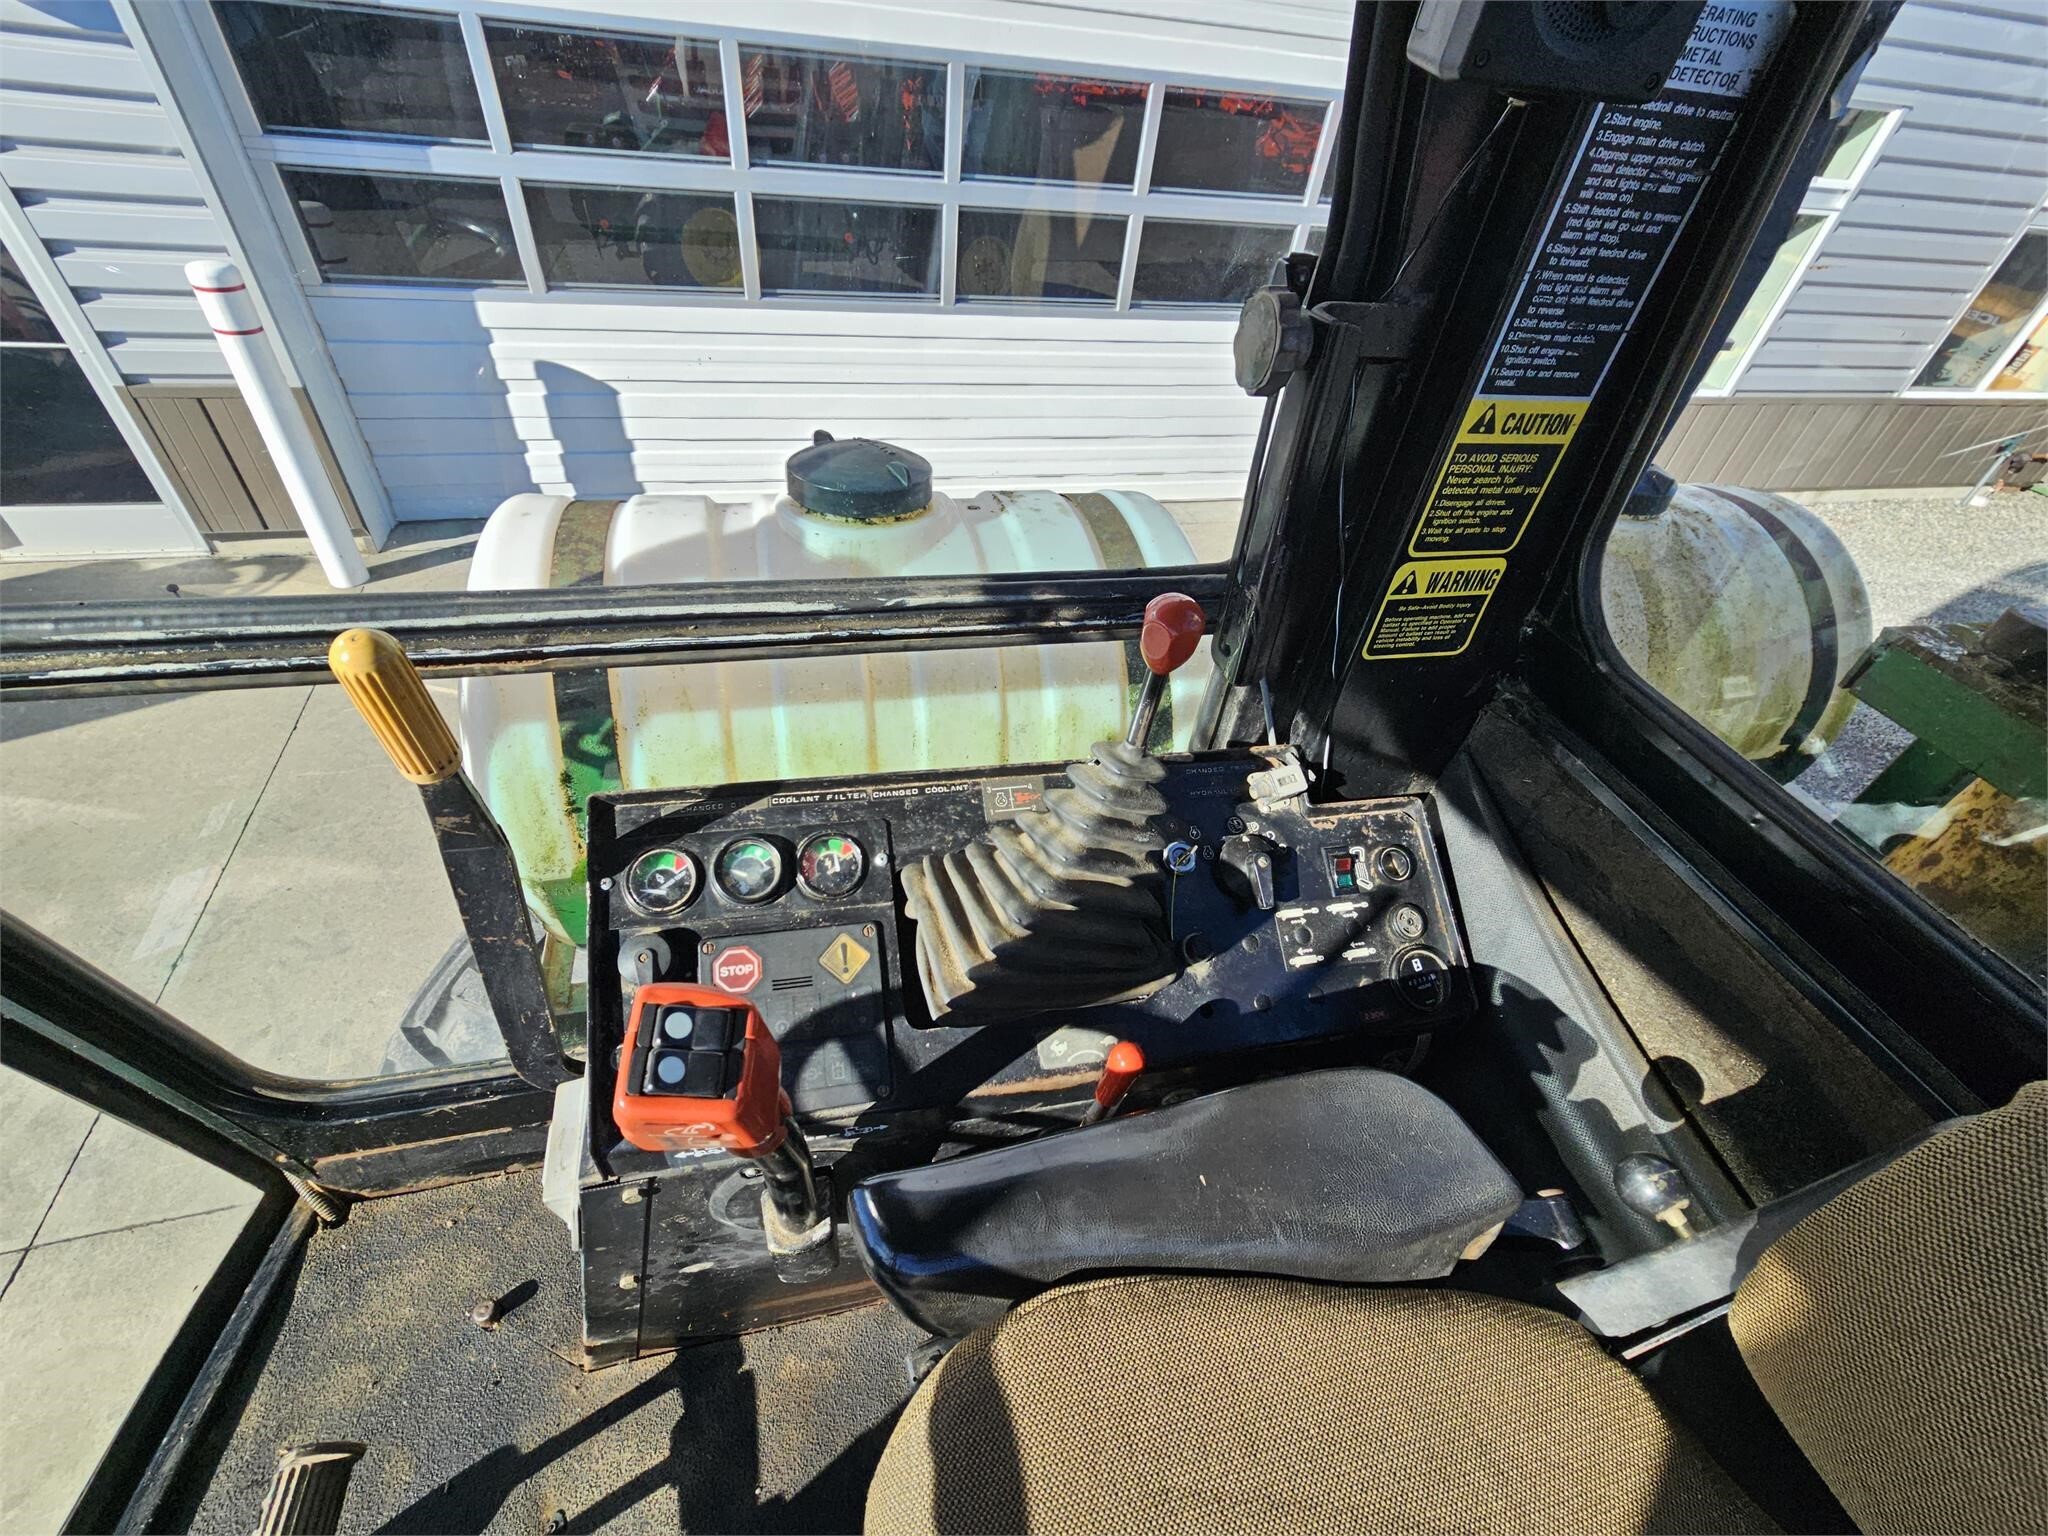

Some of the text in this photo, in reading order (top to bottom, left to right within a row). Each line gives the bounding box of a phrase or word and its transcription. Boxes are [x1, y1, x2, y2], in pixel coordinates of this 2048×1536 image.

[1680, 45, 1722, 65] METAL
[1669, 65, 1740, 90] DETECTOR
[1673, 103, 1694, 116] drive
[1695, 106, 1705, 117] to
[1602, 111, 1662, 130] 2.Start engine.
[1596, 129, 1635, 145] 3.Engage
[1635, 135, 1656, 146] main
[1657, 137, 1679, 149] drive
[1588, 147, 1697, 168] 4.Depress upper portion of
[1591, 162, 1615, 173] metal
[1615, 164, 1650, 177] detector
[1584, 176, 1602, 185] and
[1602, 177, 1618, 187] red
[1617, 178, 1641, 190] lights
[1658, 183, 1682, 194] alarm
[1579, 188, 1595, 198] will
[1594, 191, 1617, 200] come
[1590, 205, 1621, 217] feedroll
[1621, 208, 1641, 219] drive
[1642, 210, 1652, 220] to
[1565, 216, 1584, 228] (red
[1584, 218, 1603, 230] light
[1602, 219, 1619, 230] will
[1618, 222, 1630, 232] go
[1645, 223, 1664, 233] and
[1560, 230, 1583, 239] alarm
[1584, 231, 1600, 240] will
[1579, 246, 1598, 256] shift
[1598, 247, 1628, 258] feedroll
[1627, 249, 1647, 259] drive
[1549, 256, 1559, 266] to
[1534, 270, 1563, 281] 7.When
[1564, 272, 1587, 282] metal
[1587, 273, 1596, 282] is
[1554, 283, 1573, 294] light
[1588, 285, 1611, 295] alarm
[1587, 297, 1616, 307] feedroll
[1615, 299, 1635, 308] drive
[1527, 304, 1565, 316] to reverse
[1538, 318, 1568, 330] feedroll
[1551, 333, 1572, 343] main
[1527, 345, 1541, 356] off
[1540, 347, 1566, 358] engine
[1504, 354, 1531, 367] ignition
[1524, 367, 1538, 378] for
[1537, 369, 1553, 378] and
[1552, 370, 1580, 381] remove
[1501, 412, 1576, 435] CAUTION
[1454, 453, 1539, 462] TO AVOID SERIOUS
[1448, 464, 1534, 473] PERSONAL INJURY:
[1446, 475, 1517, 484] Never search for
[1441, 485, 1541, 496] detected metal until you
[1476, 509, 1499, 518] engine
[1499, 507, 1514, 516] and
[1443, 526, 1454, 534] for
[1454, 526, 1465, 534] all
[1463, 526, 1483, 536] parts
[1491, 525, 1507, 534] stop
[1425, 568, 1501, 594] WARNING
[771, 794, 822, 806] COOLANT
[826, 791, 868, 802] FILTER
[872, 788, 920, 800] CHANGED
[925, 783, 970, 796] COOLANT
[719, 963, 755, 978] STOP
